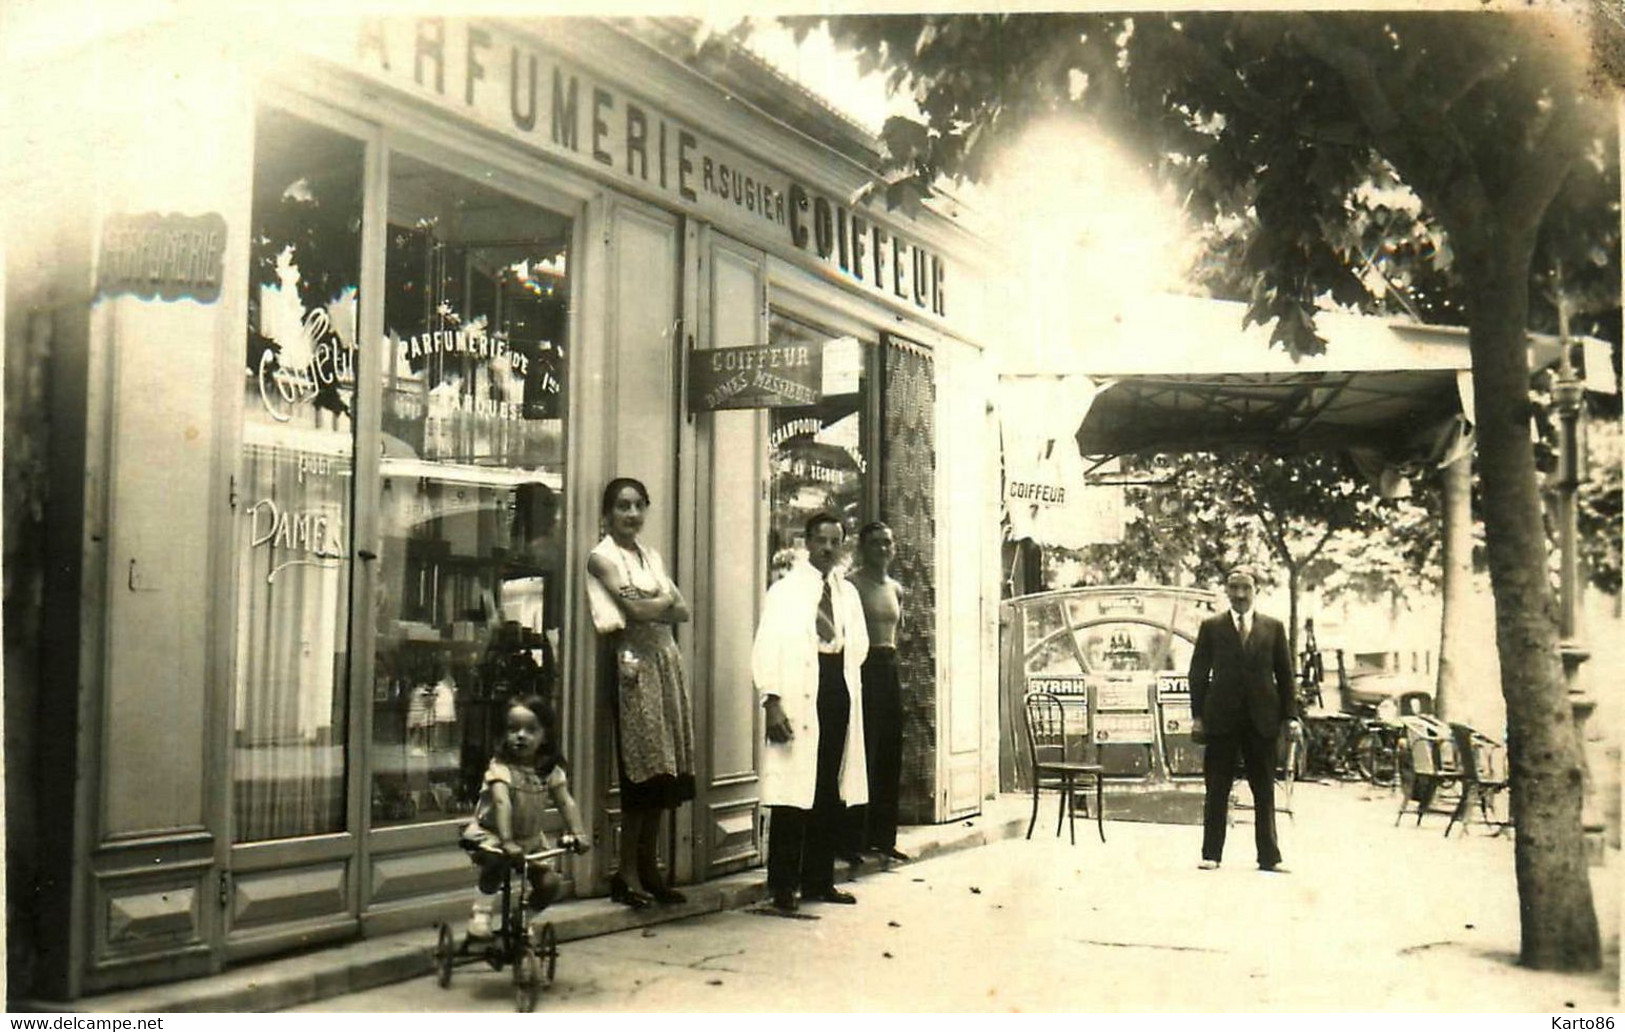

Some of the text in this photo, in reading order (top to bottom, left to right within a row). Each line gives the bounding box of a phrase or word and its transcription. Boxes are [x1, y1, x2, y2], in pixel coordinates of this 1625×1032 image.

[355, 17, 697, 203] ARFUMERIE
[788, 183, 946, 318] COIFFEUR
[398, 331, 506, 362] PARFUMERIE
[713, 346, 809, 372] COIFFEUR
[1009, 481, 1067, 504] COIFFEUR
[1030, 679, 1085, 694] BYRRH
[1159, 678, 1190, 693] BYR
